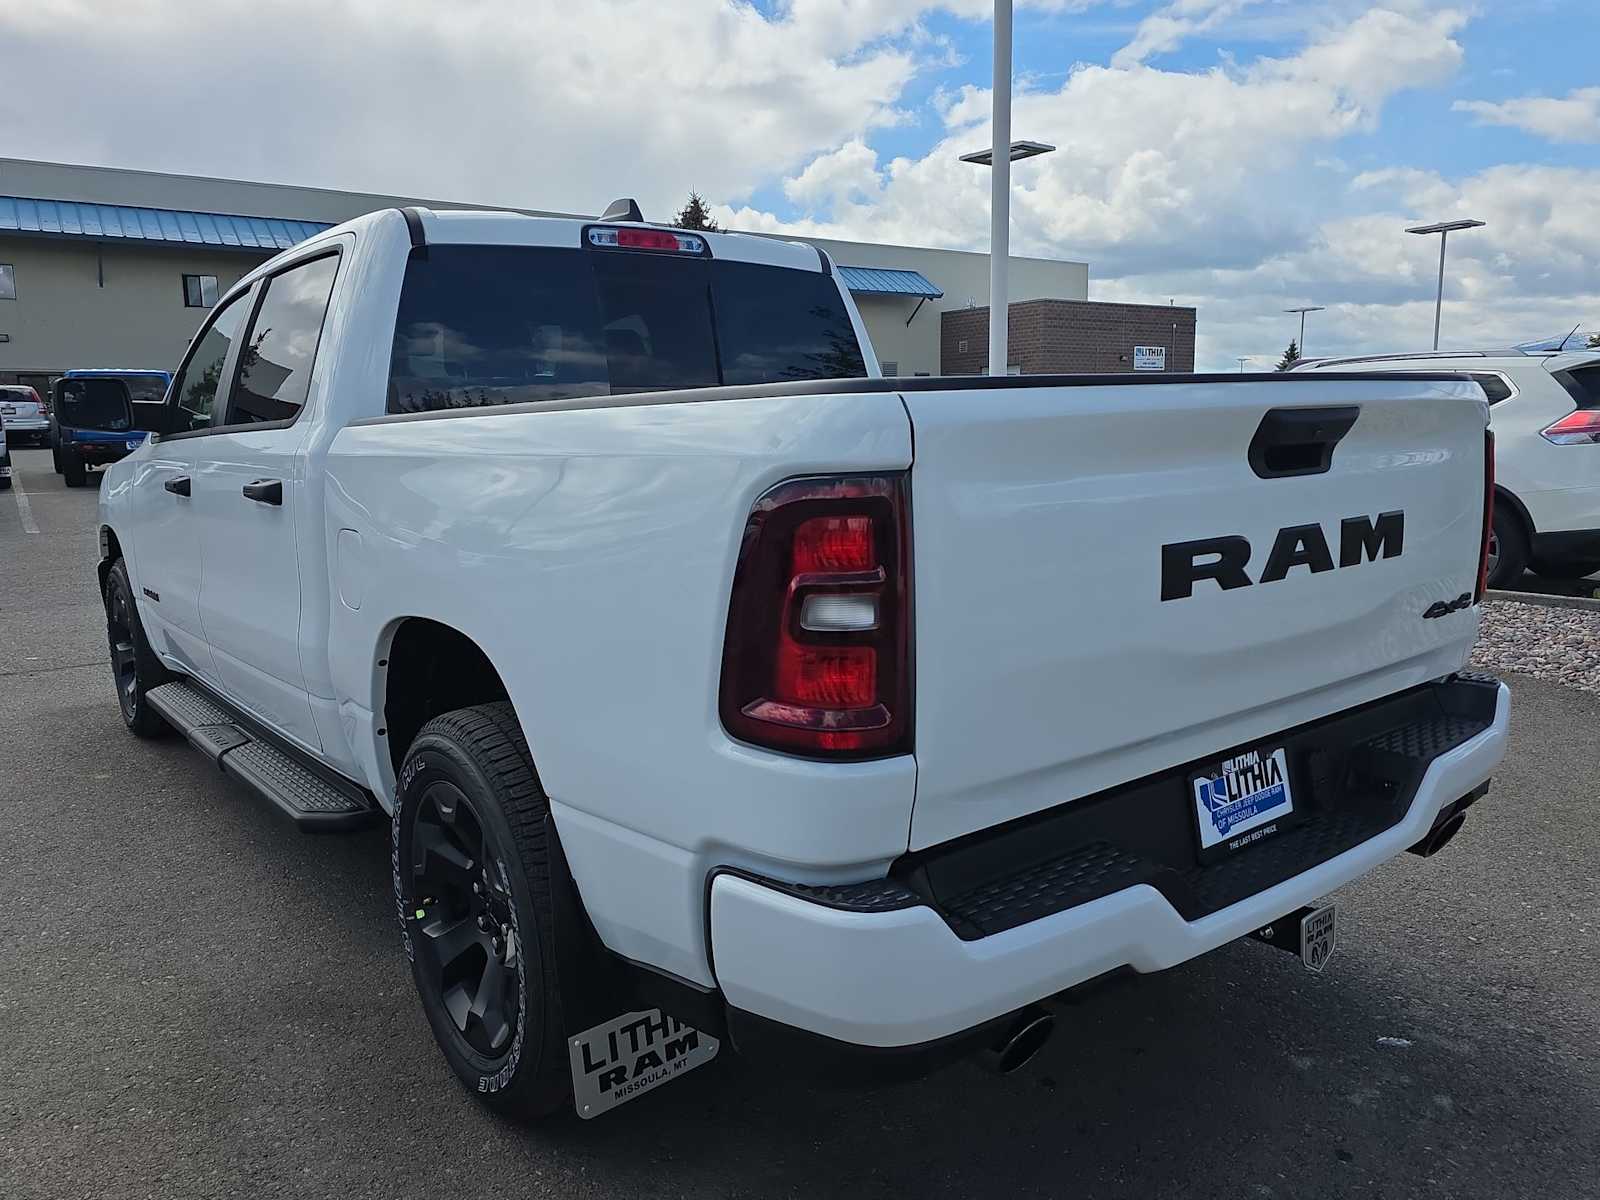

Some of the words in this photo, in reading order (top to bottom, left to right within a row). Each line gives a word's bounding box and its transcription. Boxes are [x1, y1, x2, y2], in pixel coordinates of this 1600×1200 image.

[1142, 348, 1164, 356] LITHIA
[1161, 509, 1405, 602] RAM
[1230, 750, 1260, 772] LITHIA
[1225, 757, 1283, 803] LITHIA
[1217, 818, 1228, 830] OF
[1227, 805, 1259, 825] MISSOULA
[1229, 841, 1239, 850] THE
[1239, 835, 1251, 846] LAST
[1251, 830, 1263, 841] BEST
[1263, 824, 1277, 836] PRICE
[1308, 912, 1332, 934] LITHIA
[1308, 923, 1332, 944] RAM
[598, 1030, 699, 1094] RAM
[614, 1067, 671, 1100] MISSOULA,
[673, 1057, 688, 1073] MT
